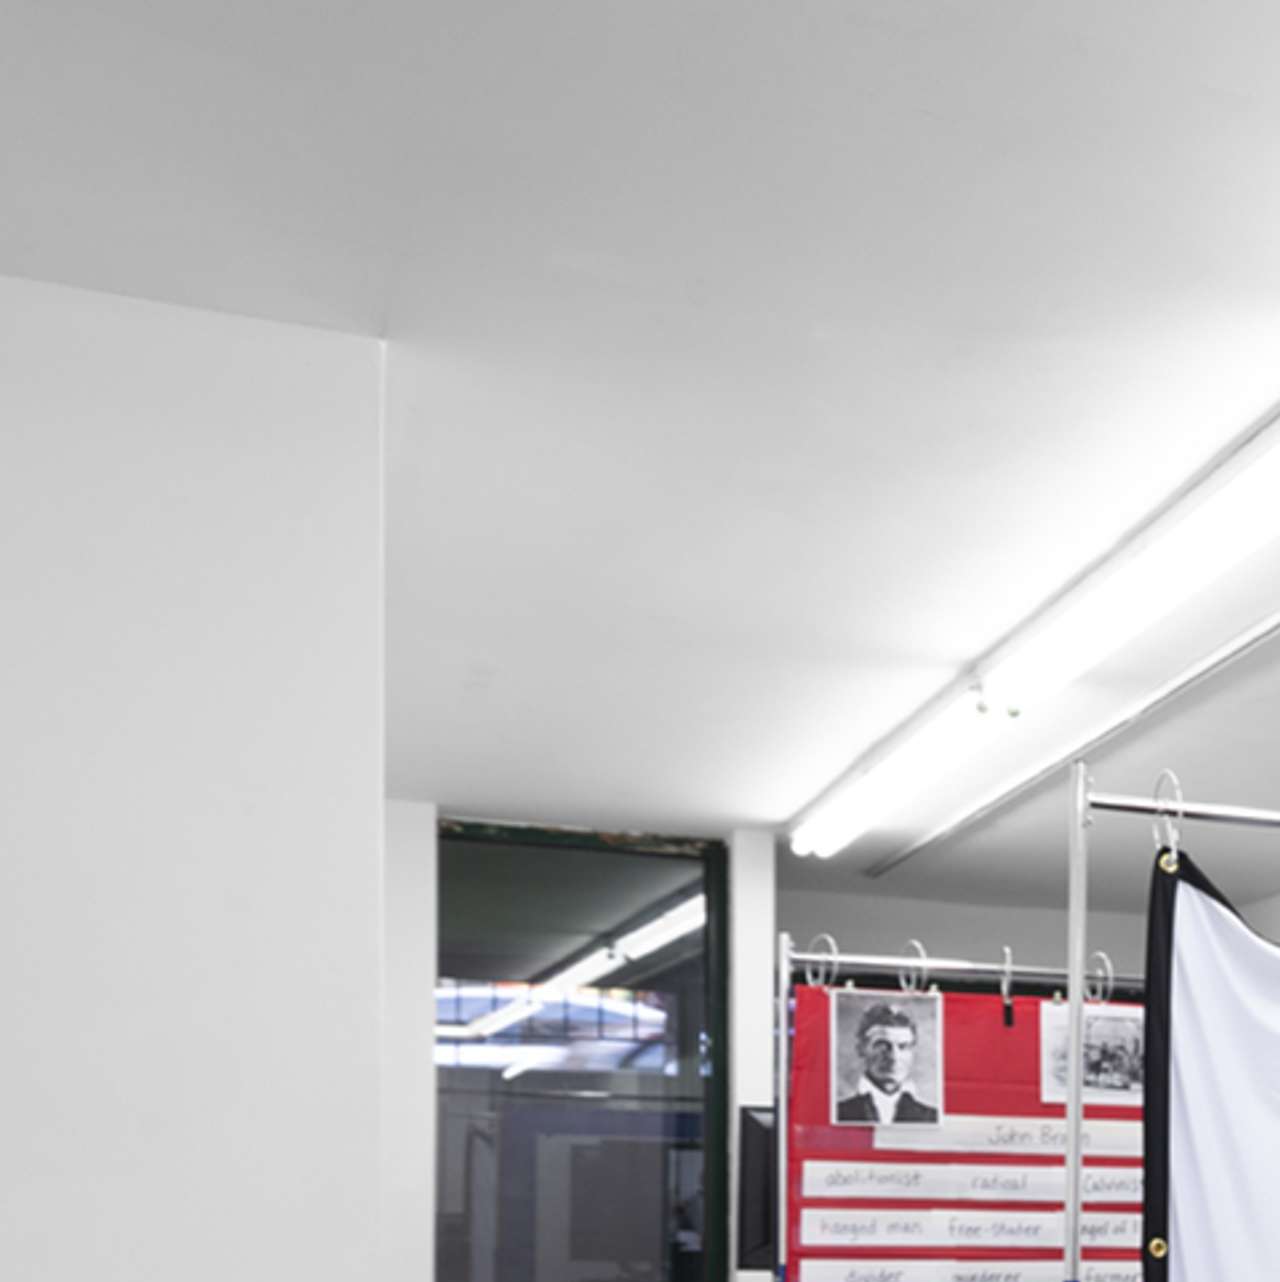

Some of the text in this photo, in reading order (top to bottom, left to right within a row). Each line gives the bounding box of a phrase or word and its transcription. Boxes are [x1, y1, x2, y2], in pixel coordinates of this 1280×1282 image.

[987, 1125, 1091, 1146] John Bron
[825, 1168, 922, 1187] abolitionist
[887, 1221, 924, 1236] man
